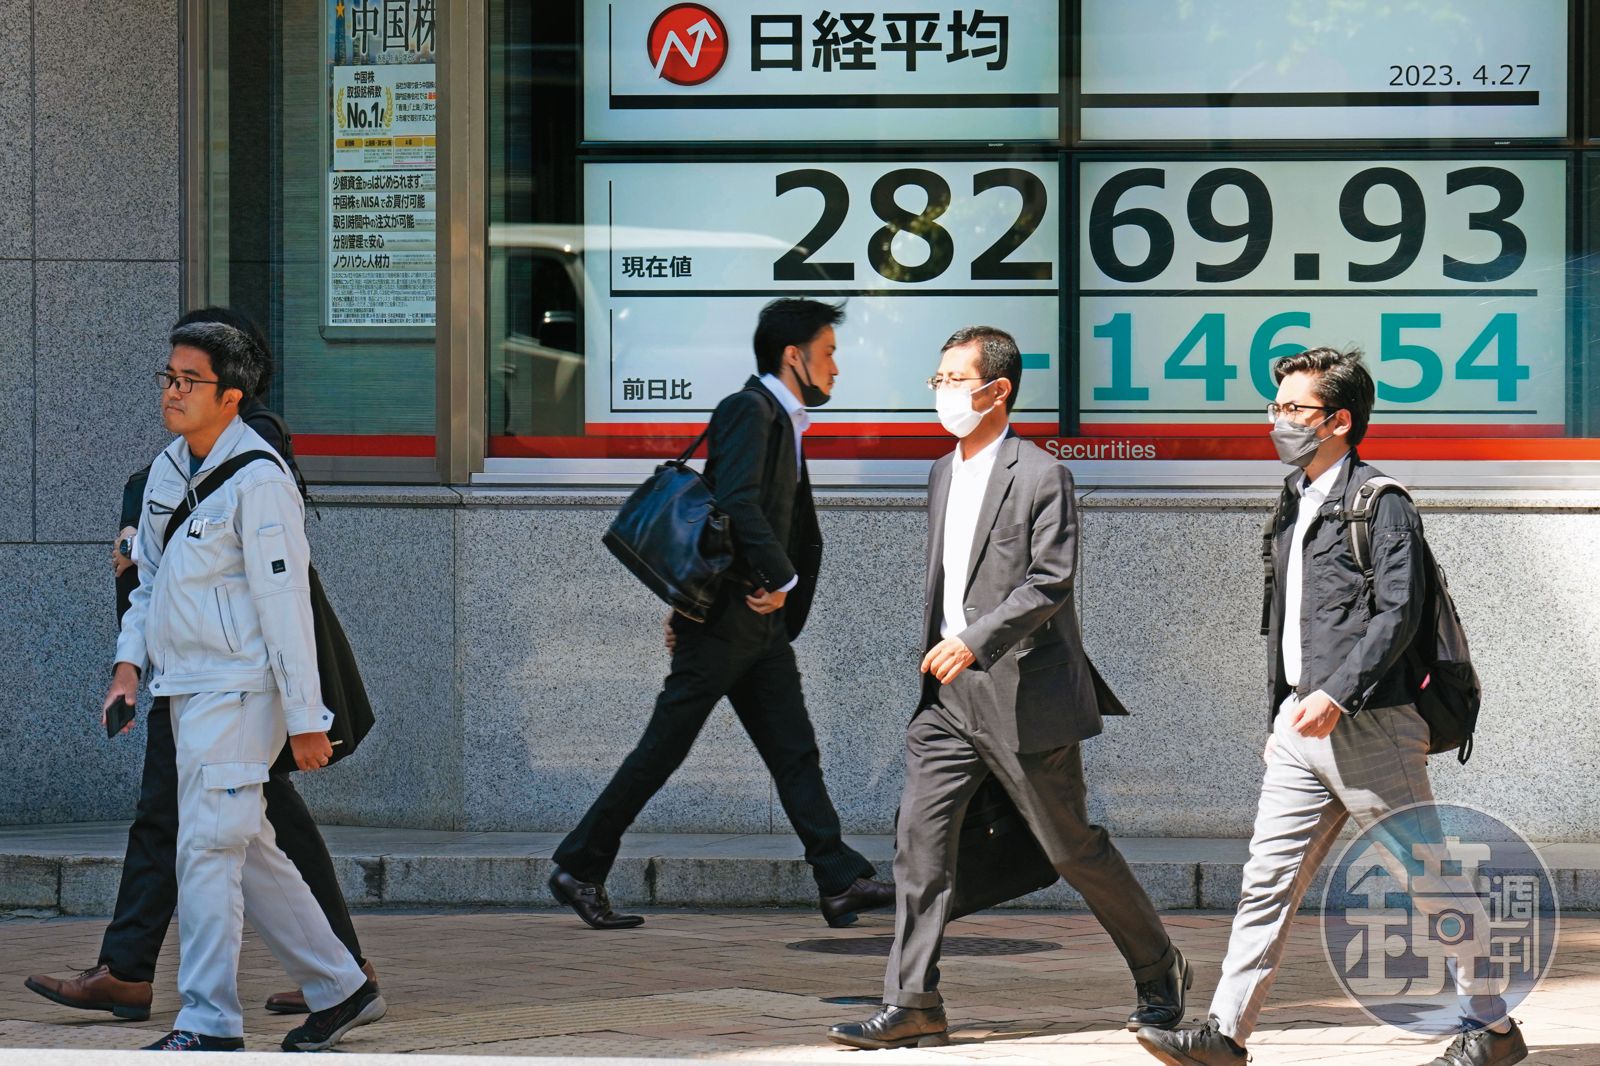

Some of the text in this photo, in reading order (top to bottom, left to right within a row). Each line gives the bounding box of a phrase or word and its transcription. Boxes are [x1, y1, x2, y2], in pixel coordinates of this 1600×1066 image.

[750, 10, 1009, 72] 日経平均
[354, 70, 375, 84] 中国株
[1389, 65, 1462, 86] 2023.
[346, 85, 382, 99] 取扱銘柄数
[346, 102, 384, 129] No.1!
[333, 214, 415, 230] 取引時間中の注文が可能
[773, 165, 1528, 283] 28269.93
[333, 234, 385, 249] 分別管理で安心
[333, 254, 390, 269] ノウハウと人材力
[621, 256, 693, 279] 現在値
[622, 377, 693, 401] 前日比
[1045, 440, 1156, 459] Securities
